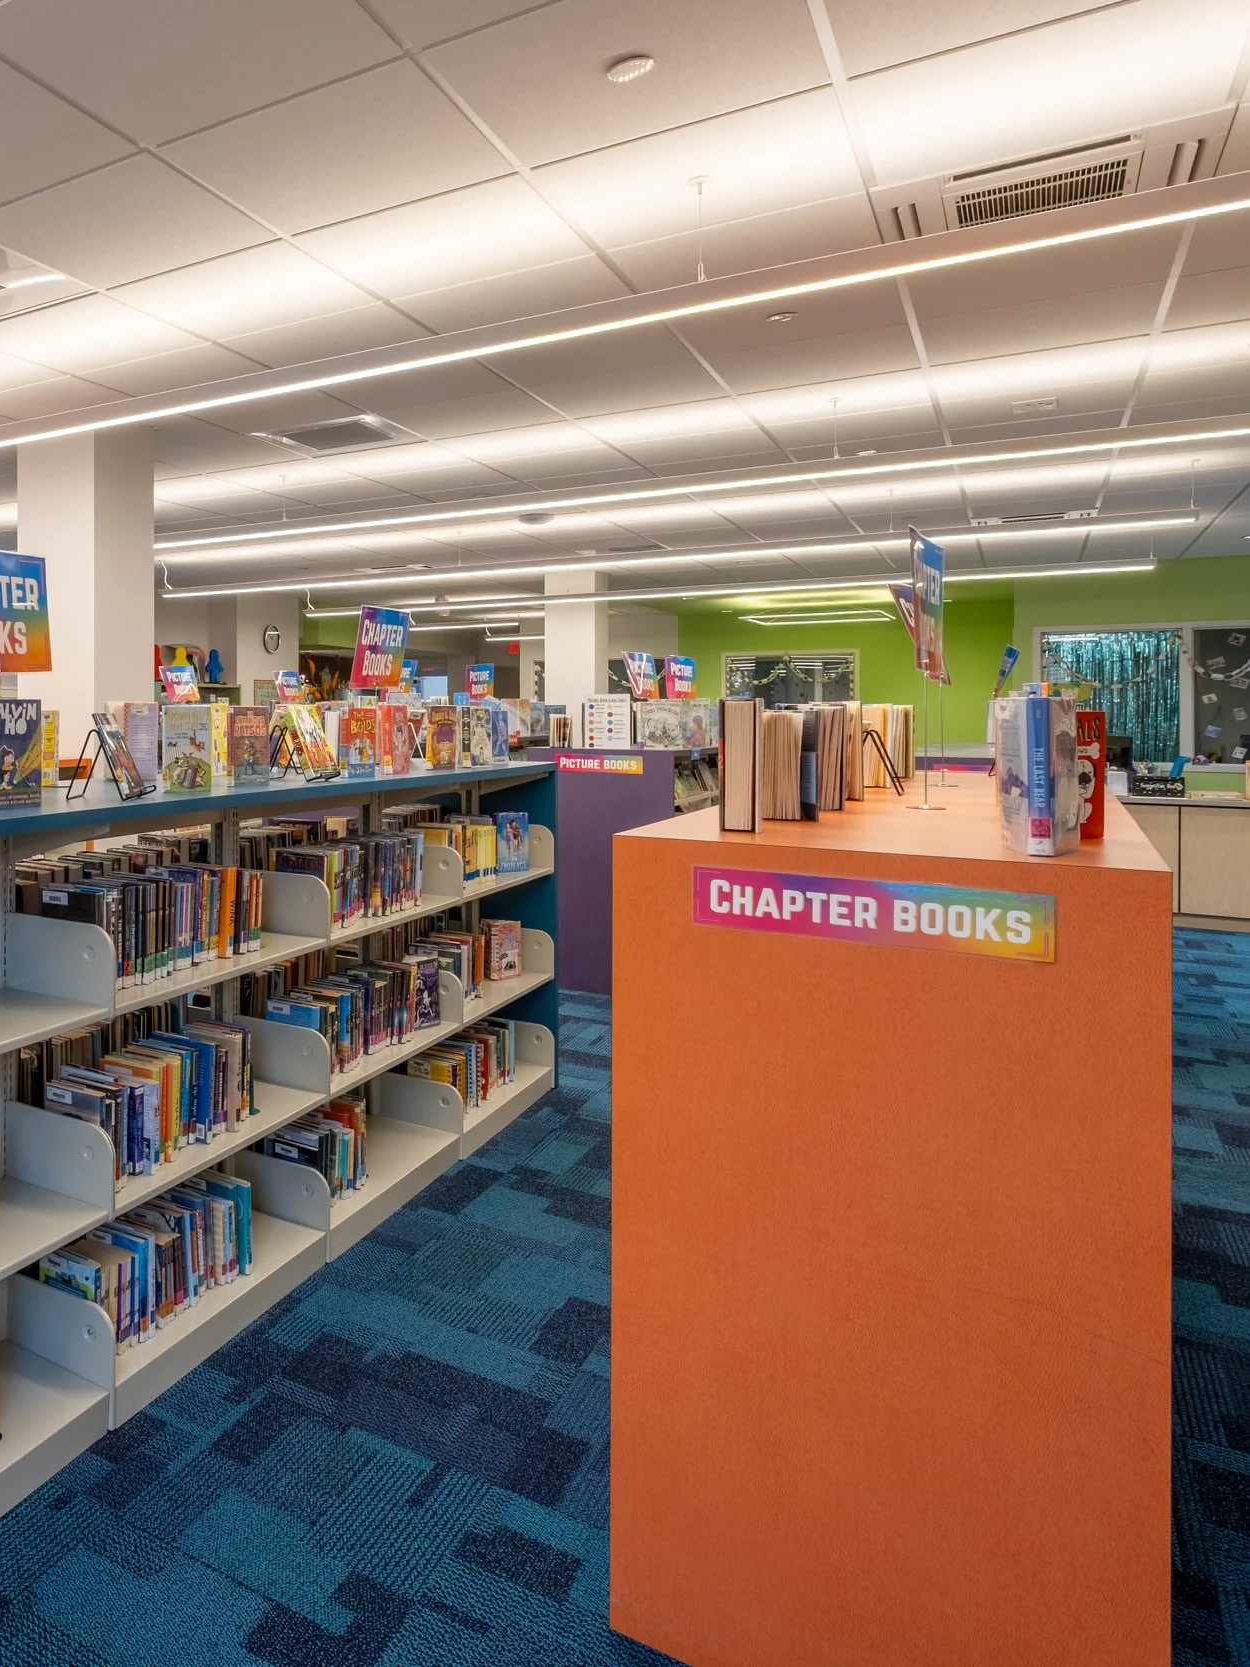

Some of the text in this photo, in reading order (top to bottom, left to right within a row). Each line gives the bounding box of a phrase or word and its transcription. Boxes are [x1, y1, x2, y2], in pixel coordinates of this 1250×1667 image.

[361, 619, 404, 647] CHAPTER
[361, 650, 394, 676] BOOKS
[670, 662, 693, 678] PICTURE
[469, 670, 490, 682] PICTURE
[471, 683, 488, 695] BOOKS
[674, 679, 692, 693] BOOKS
[4, 717, 27, 735] HO
[559, 756, 638, 770] PICTURE BOOKS
[1033, 748, 1046, 809] THE LAST BEAR
[709, 878, 1032, 946] CHAPTER BOOKS
